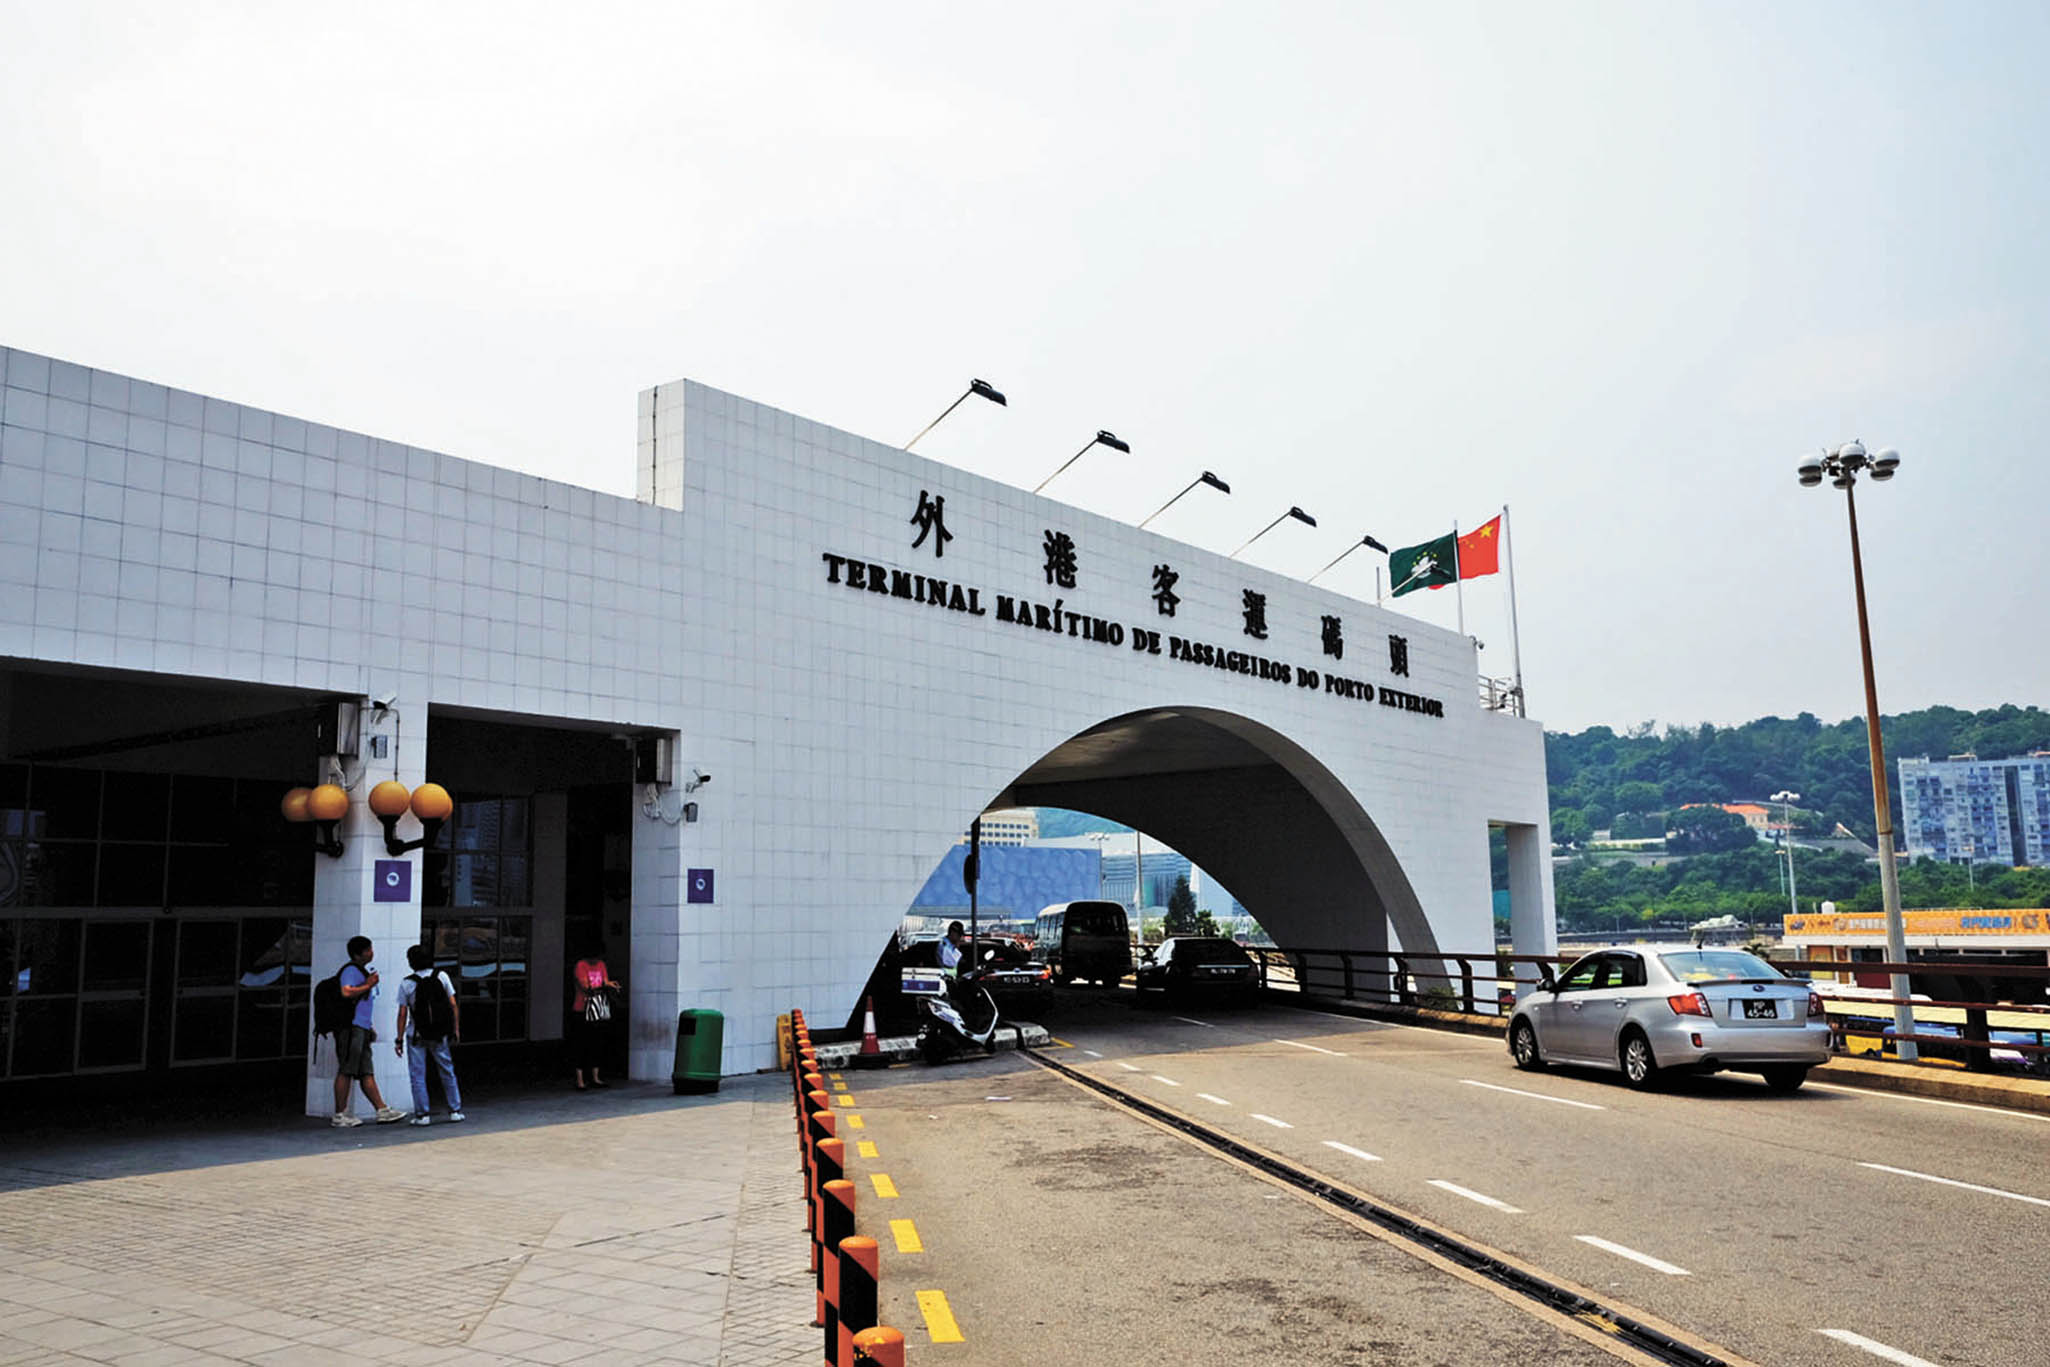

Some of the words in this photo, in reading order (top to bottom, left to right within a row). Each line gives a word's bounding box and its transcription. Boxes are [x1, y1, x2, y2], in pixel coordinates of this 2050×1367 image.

[822, 552, 986, 616] TERMINAL
[996, 594, 1125, 646] MARÍTIMO
[1132, 627, 1162, 655] DE
[1169, 636, 1292, 684] PASSAGEIROS
[1296, 667, 1319, 690] DO
[1324, 673, 1374, 702] PORTO
[1378, 686, 1444, 718] EXTERIOR
